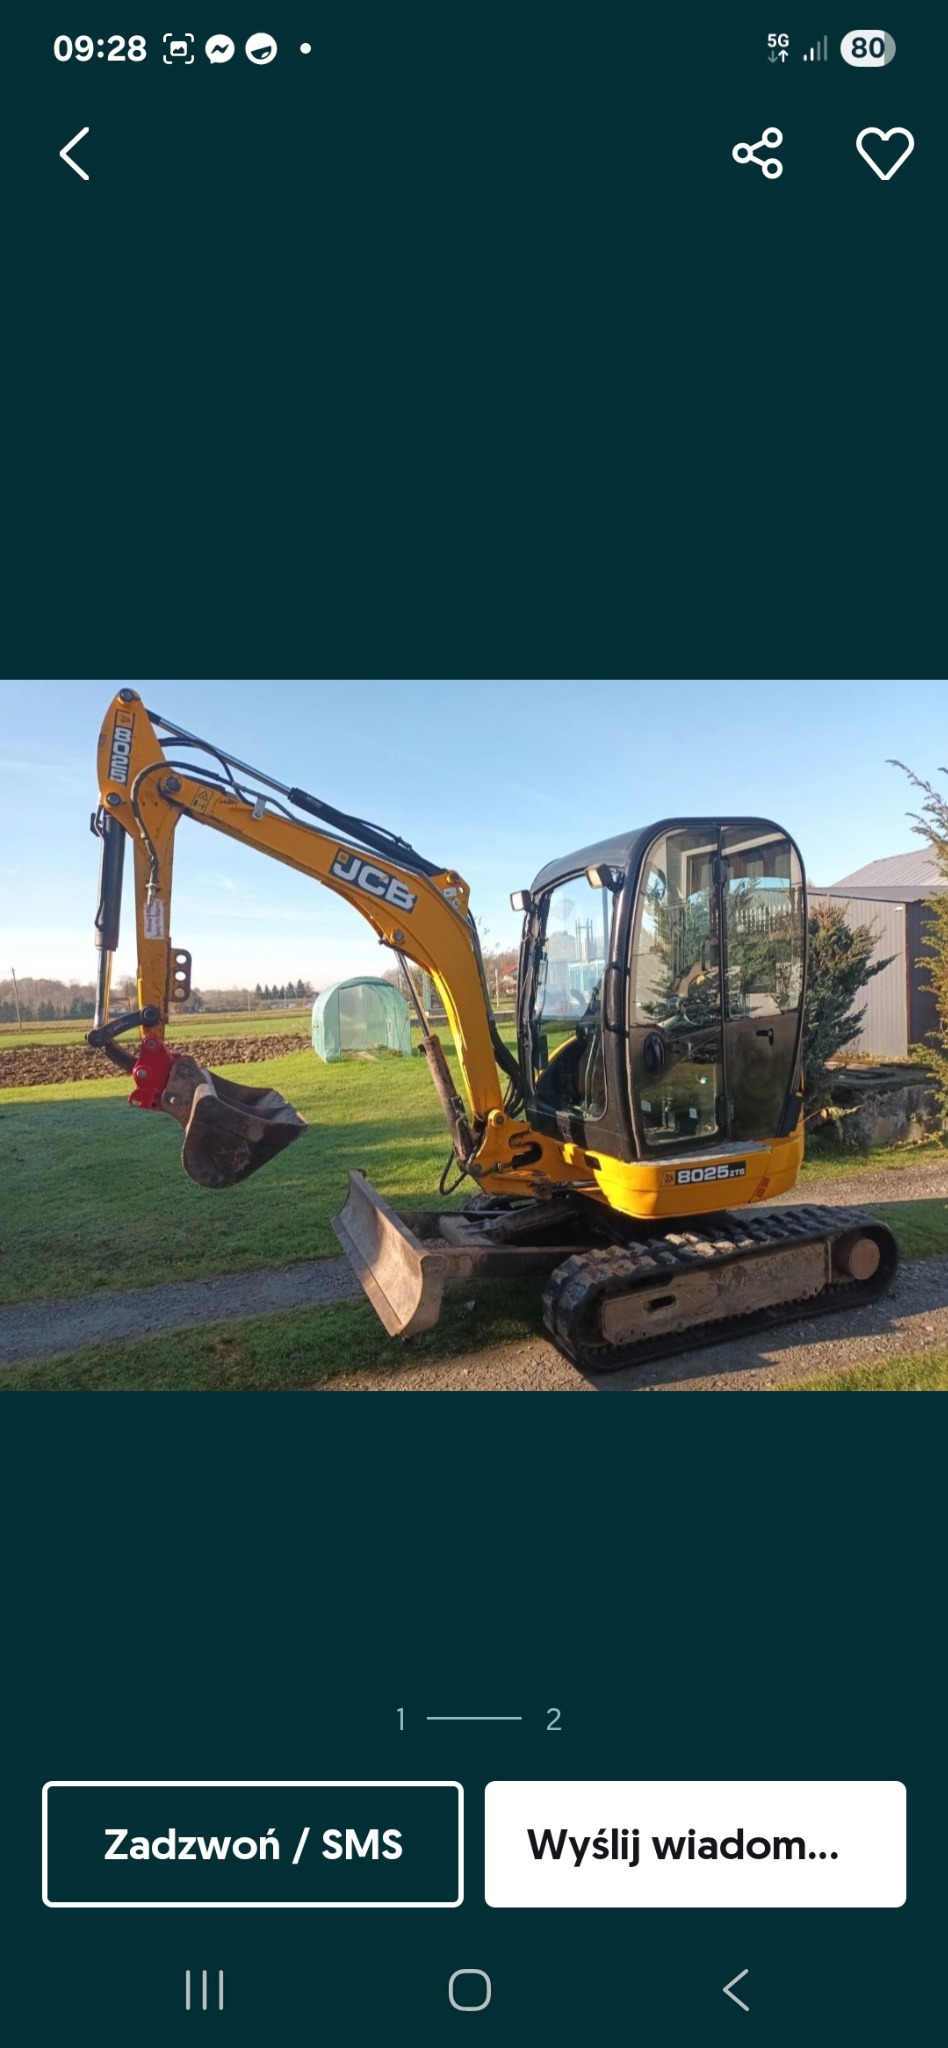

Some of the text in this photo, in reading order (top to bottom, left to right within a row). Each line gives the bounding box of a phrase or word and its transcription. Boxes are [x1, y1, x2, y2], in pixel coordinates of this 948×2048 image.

[109, 726, 133, 784] 8025
[332, 858, 417, 911] JCB
[677, 1164, 730, 1184] 8025
